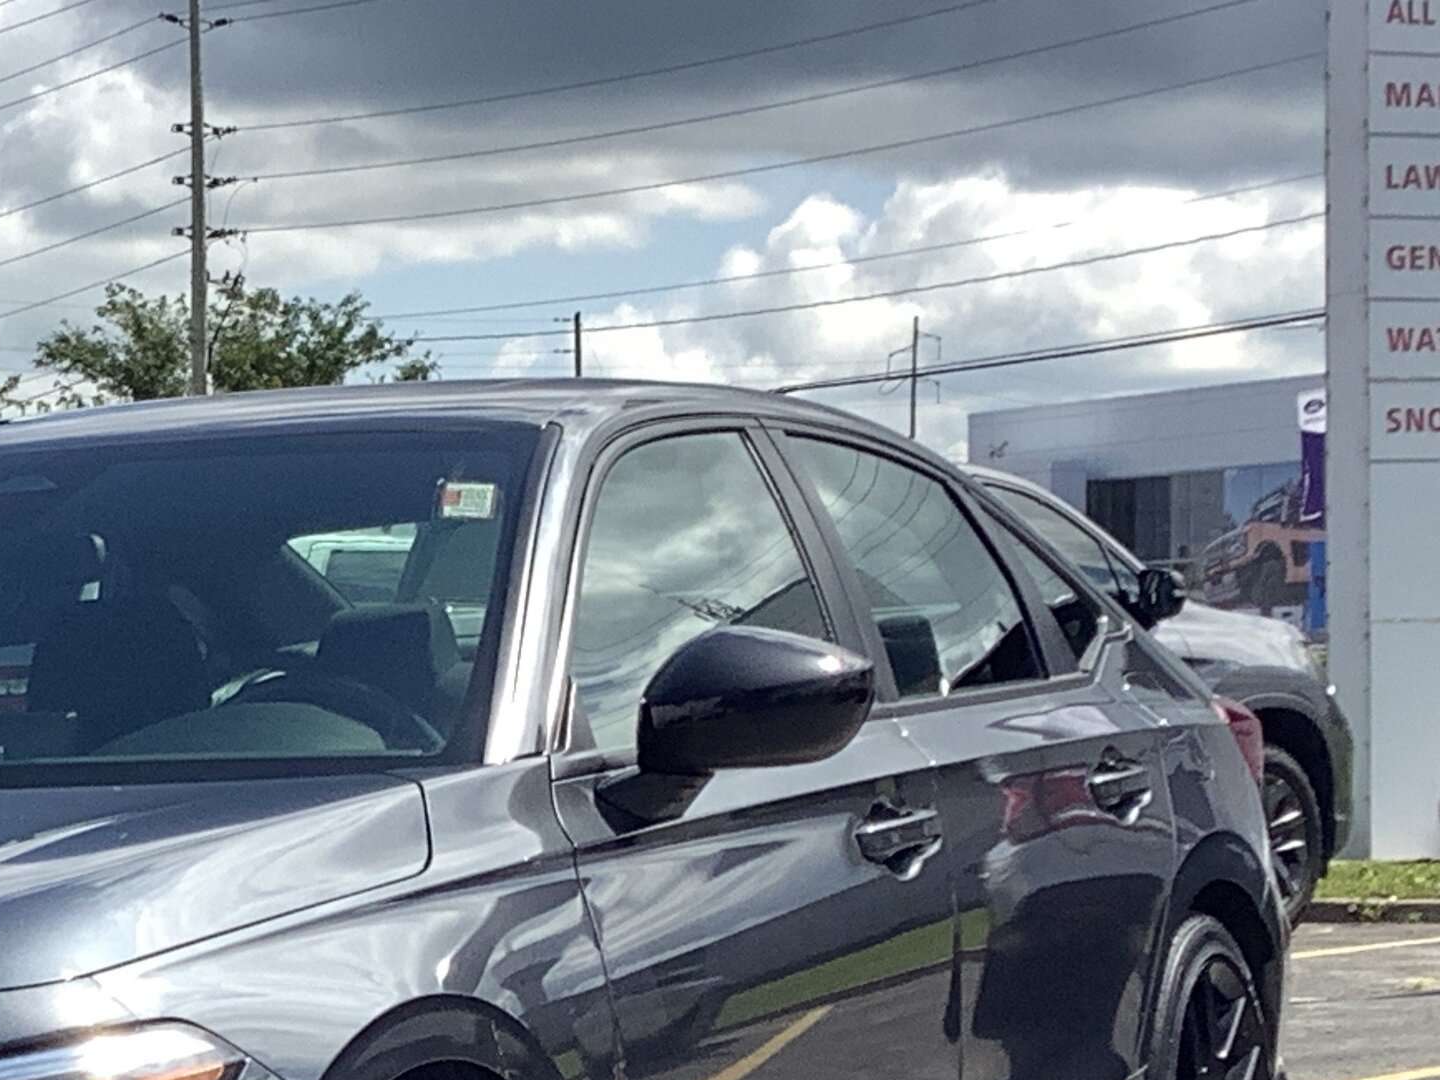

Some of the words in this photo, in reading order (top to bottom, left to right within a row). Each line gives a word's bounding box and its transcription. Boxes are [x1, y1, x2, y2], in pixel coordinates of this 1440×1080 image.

[1386, 0, 1437, 26] ALL
[1385, 82, 1440, 108] MA
[1386, 327, 1440, 352] WA
